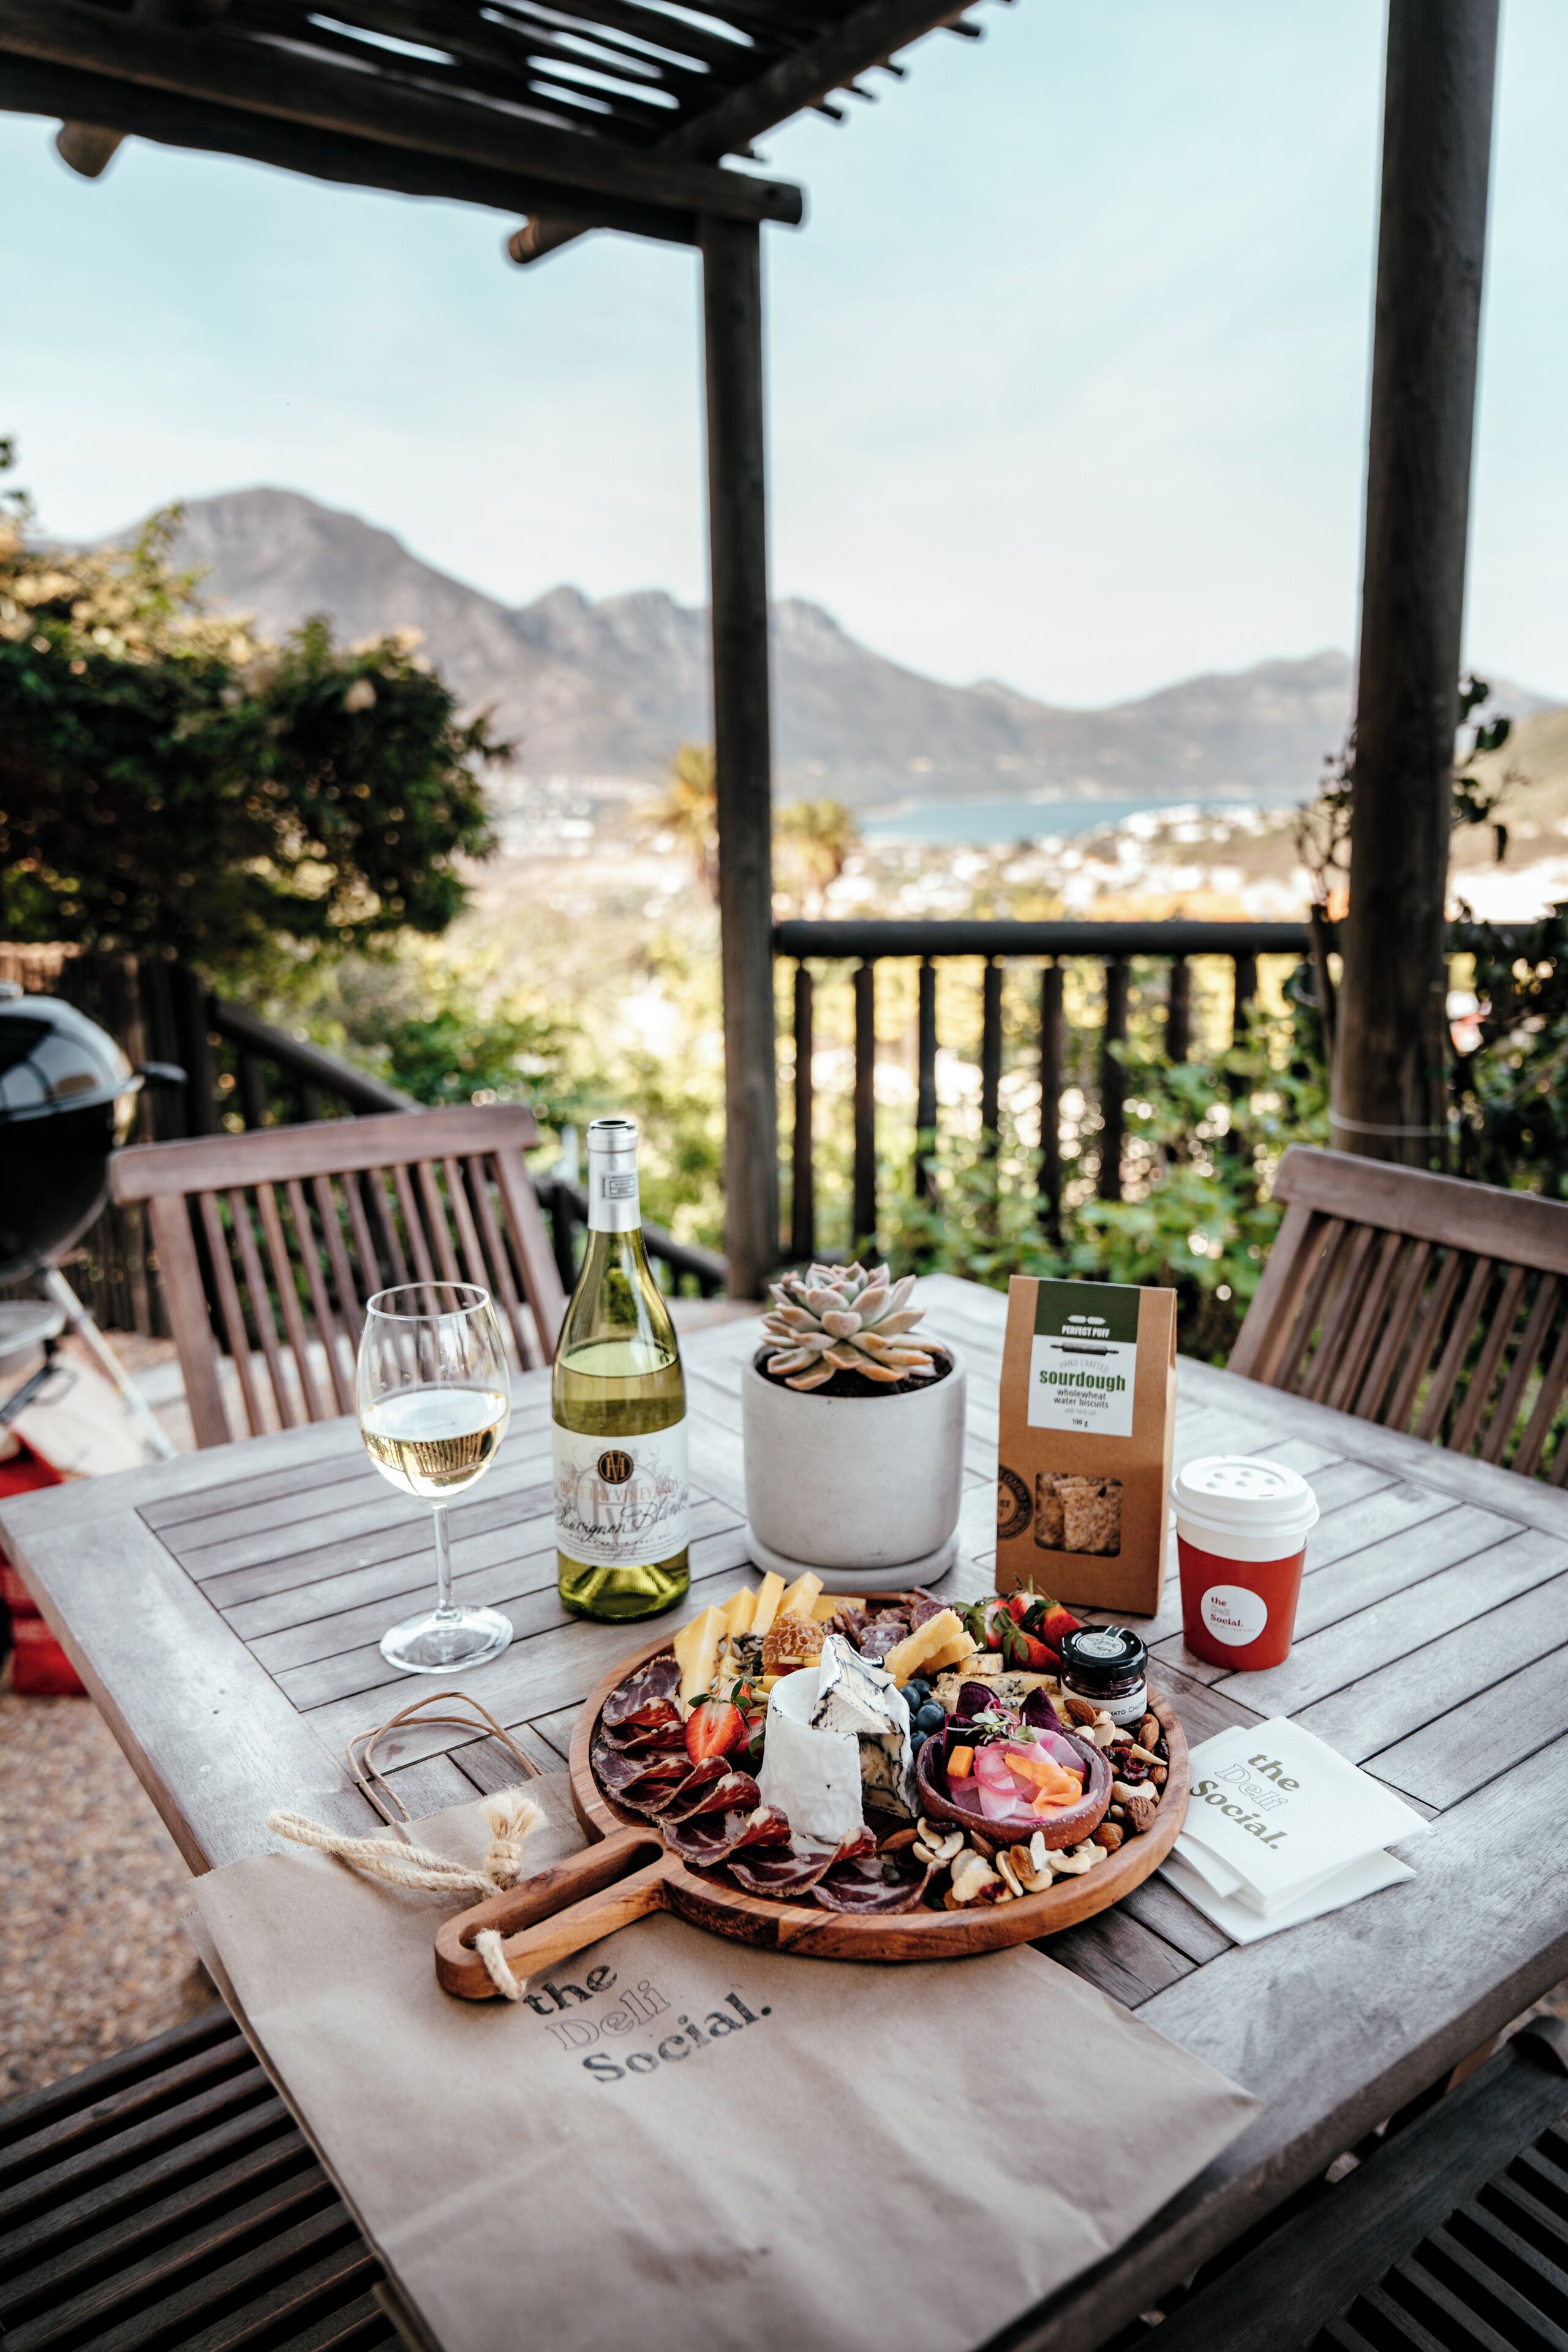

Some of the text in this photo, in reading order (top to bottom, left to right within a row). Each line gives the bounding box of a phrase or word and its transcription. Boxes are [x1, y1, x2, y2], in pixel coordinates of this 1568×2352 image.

[1061, 1324, 1110, 1338] PERFECT PUFF
[1059, 1357, 1109, 1373] HAND CRAFTED
[1039, 1370, 1126, 1392] sourdough
[1054, 1397, 1109, 1409] water biscuits
[1057, 1389, 1106, 1400] wholewheat
[1211, 1597, 1227, 1606] the
[1210, 1613, 1243, 1627] Social.
[1247, 1754, 1300, 1792] the
[1215, 1763, 1288, 1811] Deli
[1189, 1780, 1288, 1850] Social.
[523, 1965, 617, 2016] the
[545, 1980, 671, 2051] Deli
[582, 1992, 772, 2082] Social.
